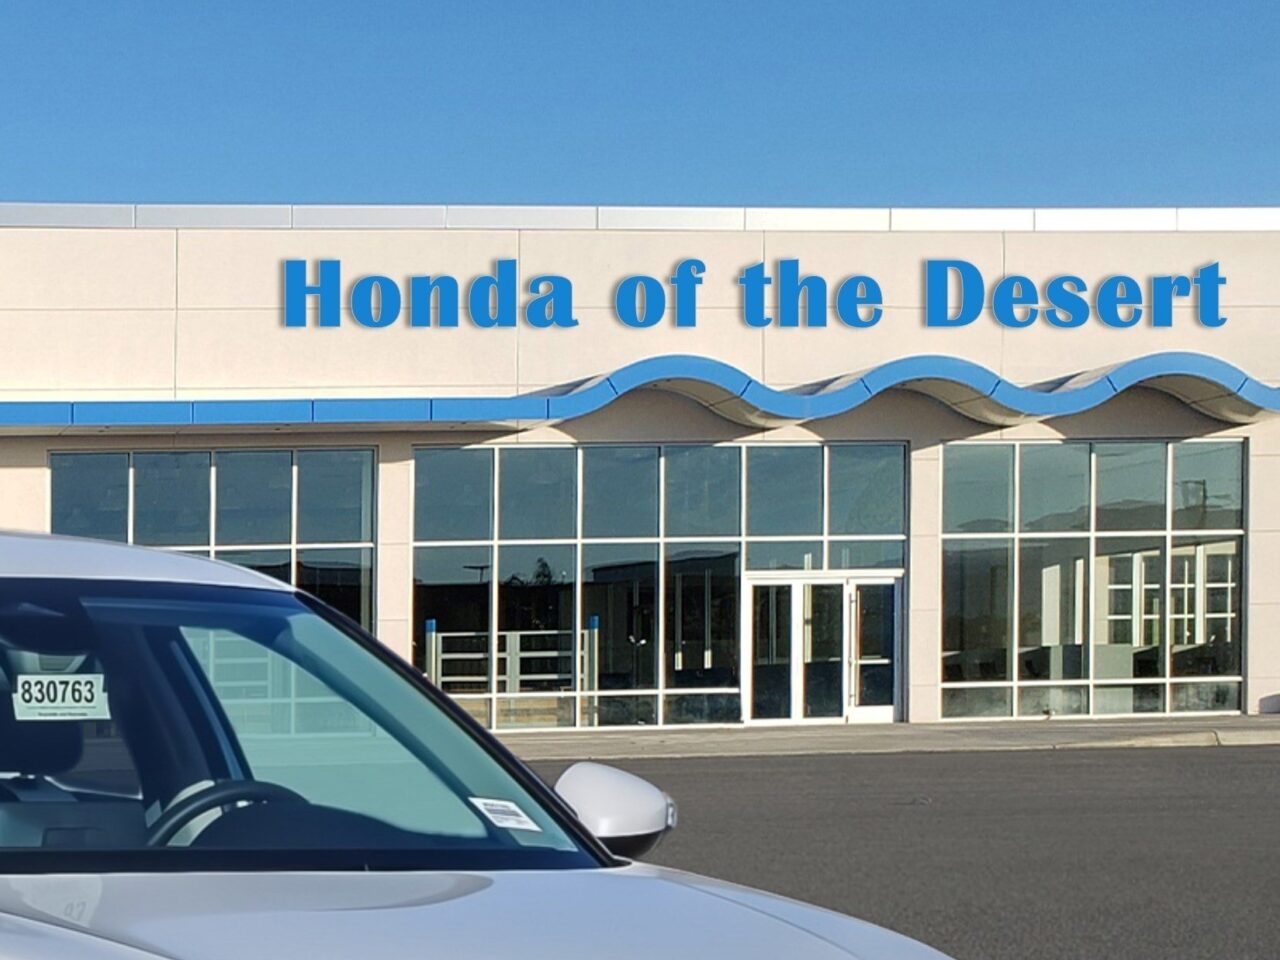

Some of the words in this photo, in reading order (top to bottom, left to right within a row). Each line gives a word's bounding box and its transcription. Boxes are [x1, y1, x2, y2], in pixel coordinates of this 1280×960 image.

[283, 258, 579, 328] Honda
[613, 258, 706, 328] of
[737, 258, 883, 328] the
[924, 259, 1227, 328] Desert
[20, 680, 95, 704] 830763
